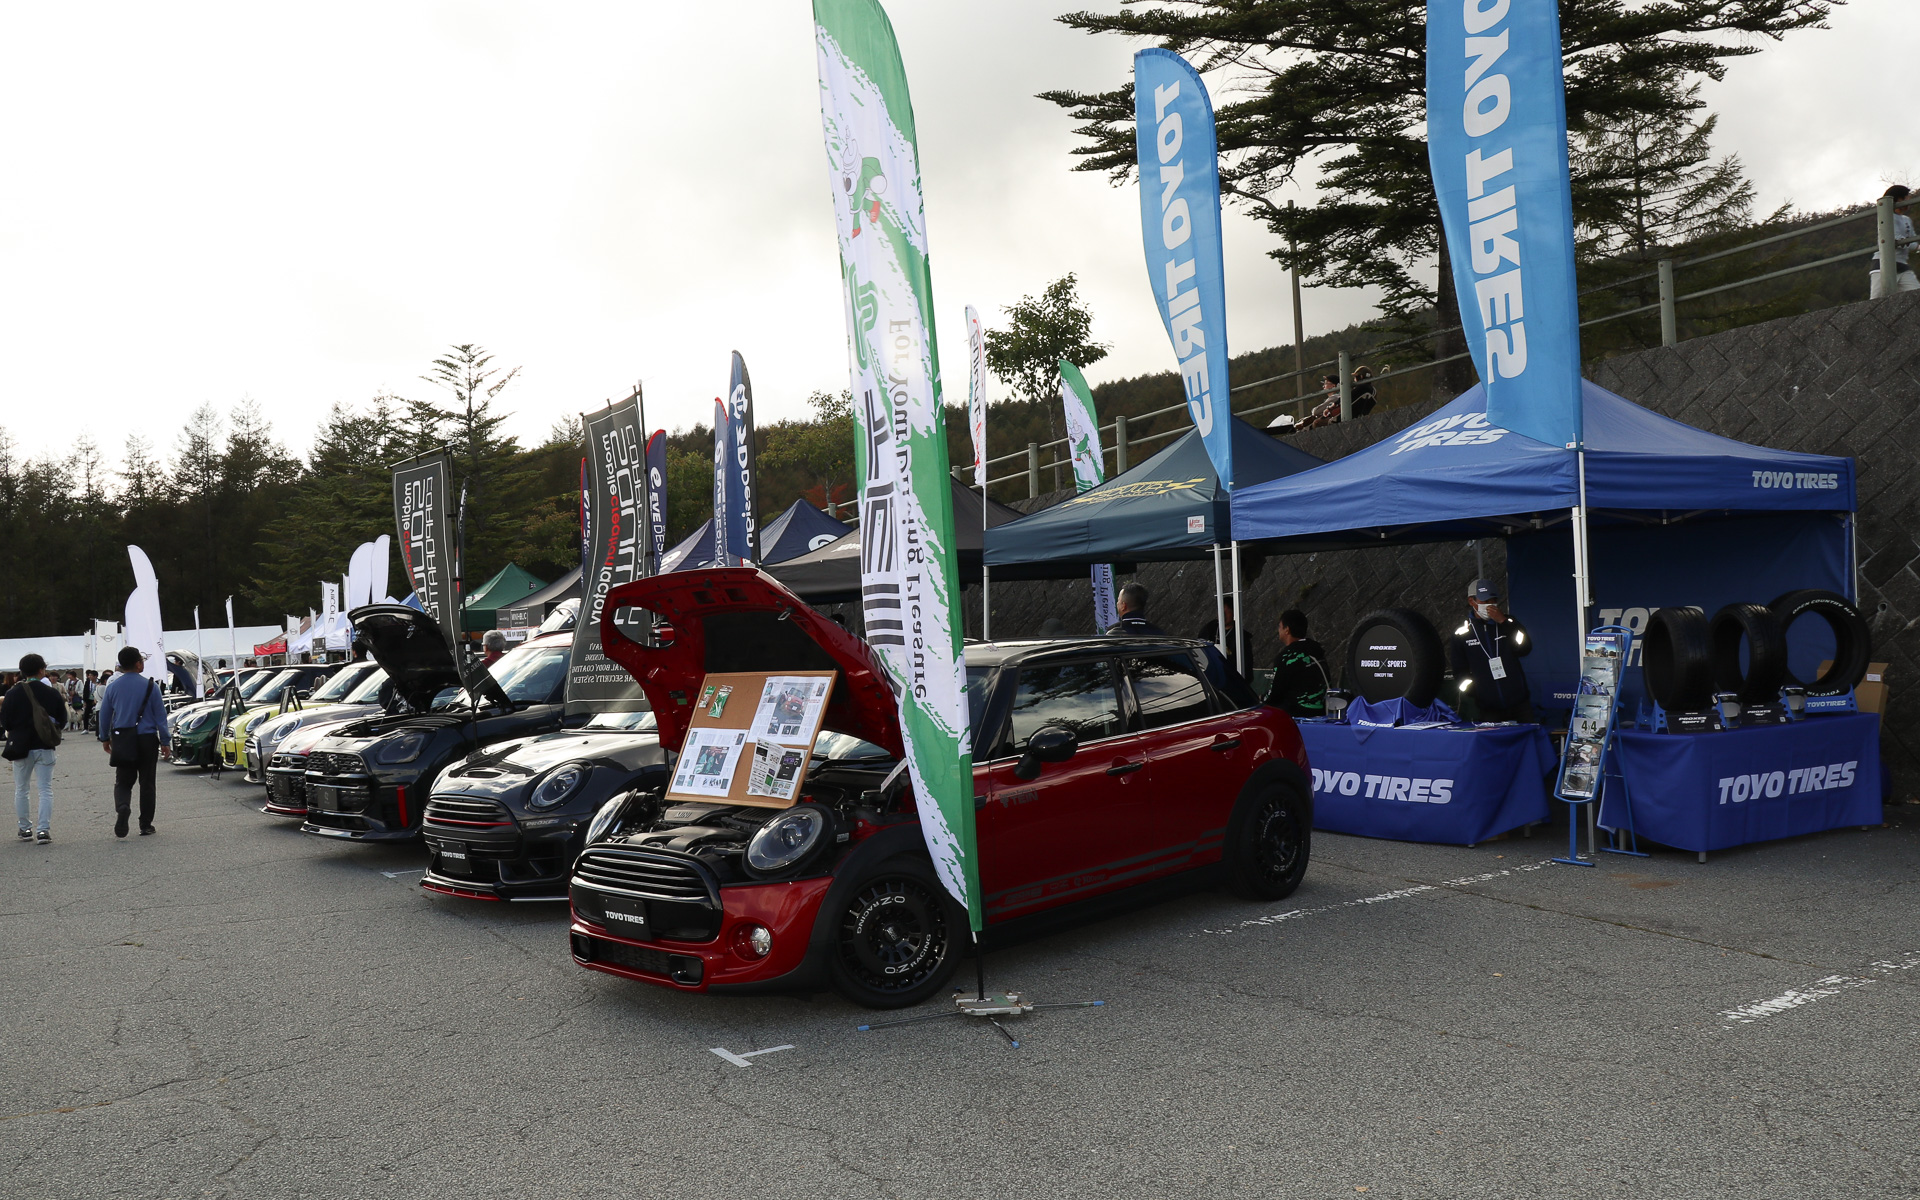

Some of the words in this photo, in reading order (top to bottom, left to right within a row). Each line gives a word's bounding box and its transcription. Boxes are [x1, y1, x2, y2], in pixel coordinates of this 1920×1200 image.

[1389, 429, 1510, 456] TIRES
[1752, 471, 1794, 489] TOYO
[1795, 473, 1838, 489] TIRES
[651, 492, 662, 522] EVE
[1811, 599, 1843, 607] COUNTRY
[1310, 768, 1361, 796] OYO
[1364, 774, 1454, 804] TIRES
[1718, 771, 1785, 805] TOYO
[1788, 760, 1858, 795] TIRES
[605, 910, 624, 920] TOYO
[624, 913, 645, 925] TIRES
[857, 901, 880, 934] RACING
[910, 934, 932, 968] RACING
